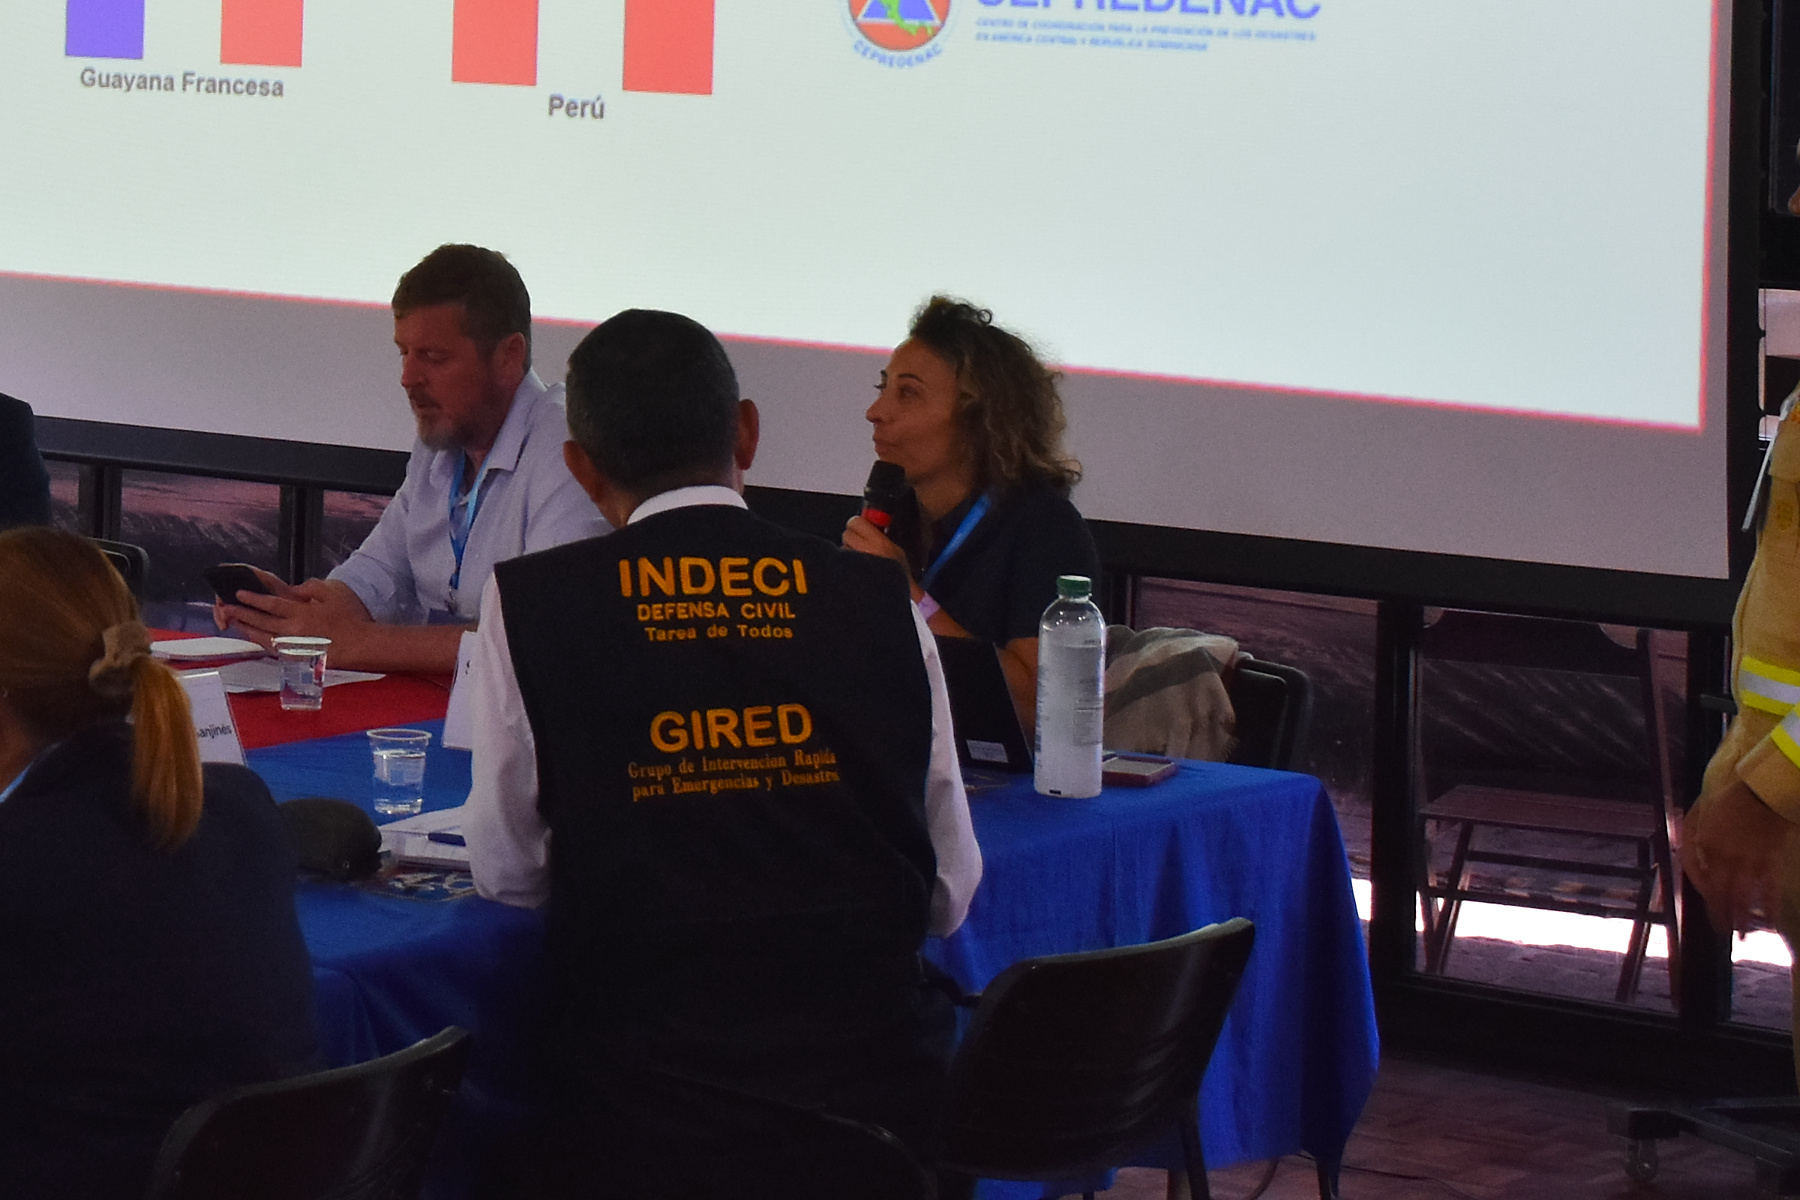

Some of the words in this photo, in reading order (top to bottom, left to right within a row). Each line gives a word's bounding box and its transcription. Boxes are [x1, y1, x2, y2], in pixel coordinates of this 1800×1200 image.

[80, 67, 175, 94] Guayana
[181, 71, 285, 99] Francesa
[548, 94, 605, 121] Perú
[618, 556, 808, 597] INDECI
[637, 601, 729, 621] DEFENSA
[740, 602, 796, 619] CIVIL
[645, 626, 697, 641] Tarea
[706, 624, 728, 638] de
[737, 624, 793, 639] Todos
[650, 703, 813, 752] GIRED
[627, 761, 672, 781] Grupo
[678, 756, 695, 775] de
[632, 784, 664, 802] para
[671, 774, 760, 794] Emergencias
[764, 776, 774, 792] y
